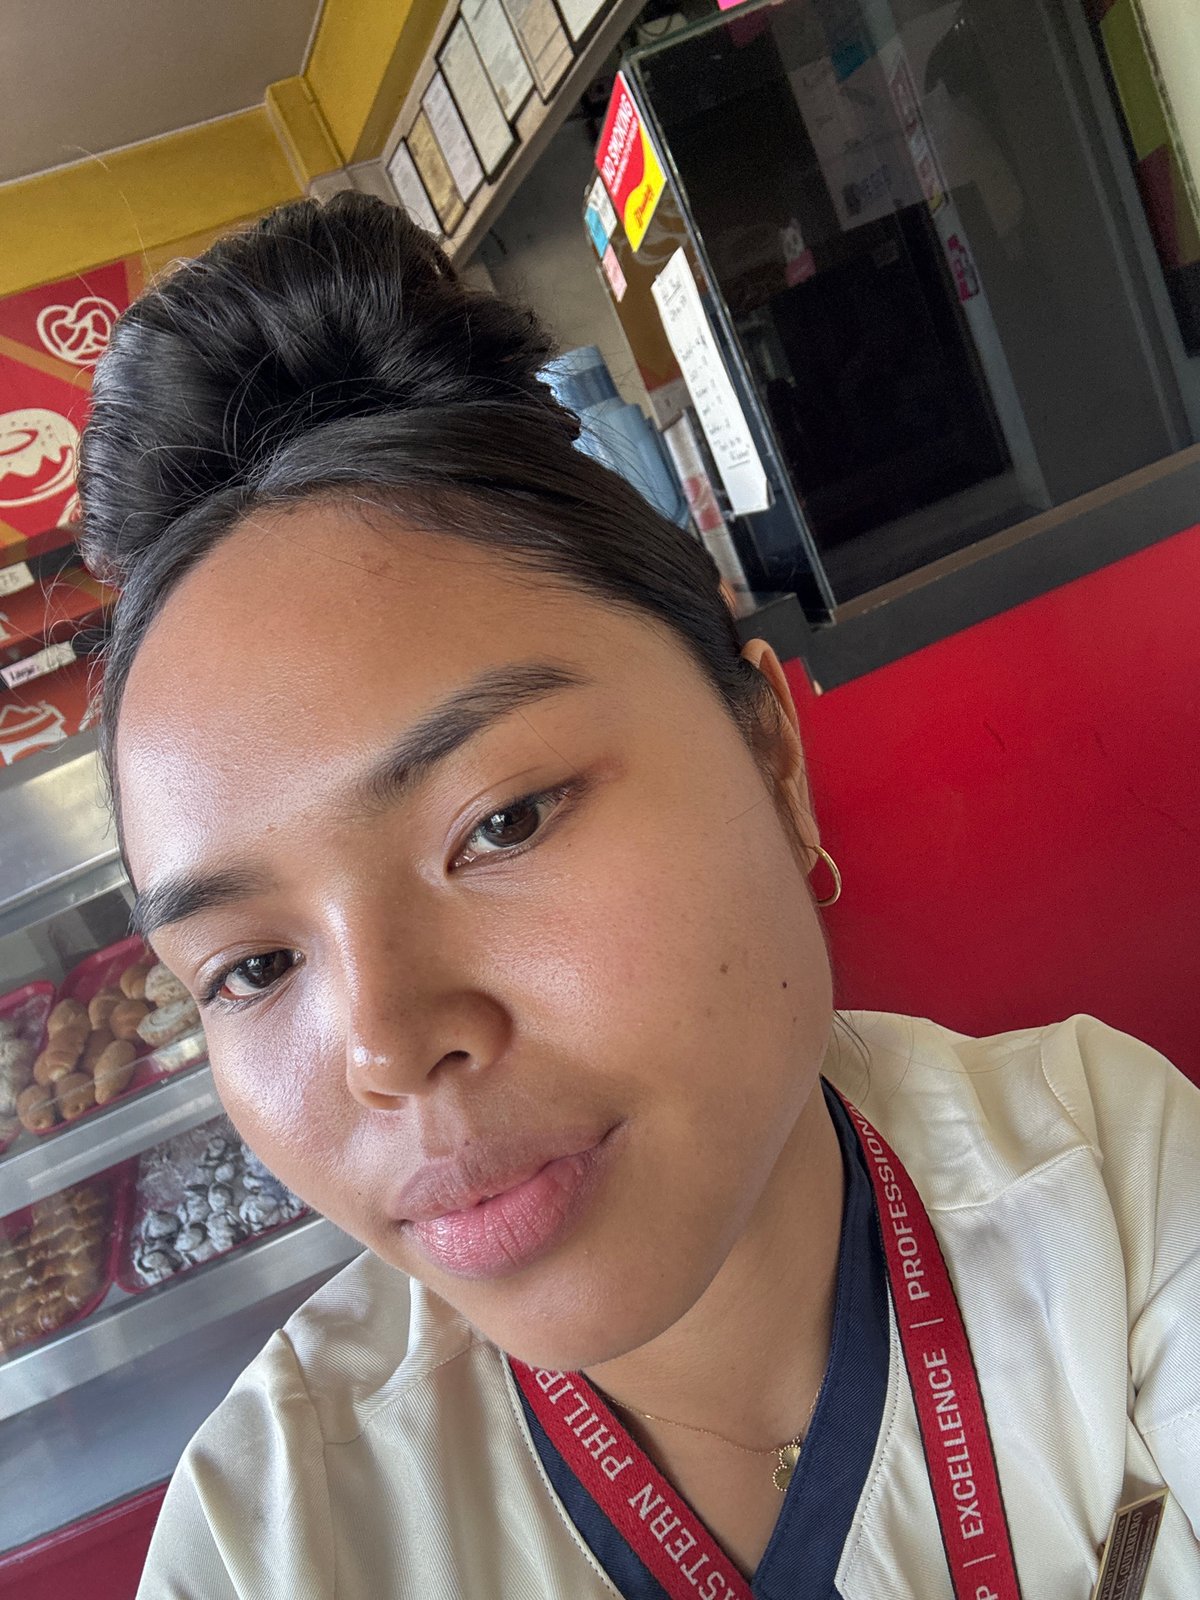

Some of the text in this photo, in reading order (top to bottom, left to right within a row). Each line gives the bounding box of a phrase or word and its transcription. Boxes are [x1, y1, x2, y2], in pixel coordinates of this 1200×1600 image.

[600, 154, 616, 188] NO
[608, 92, 633, 167] SMOKING
[529, 1365, 737, 1600] STERN PHILIP
[923, 1348, 985, 1540] EXCELLENCE
